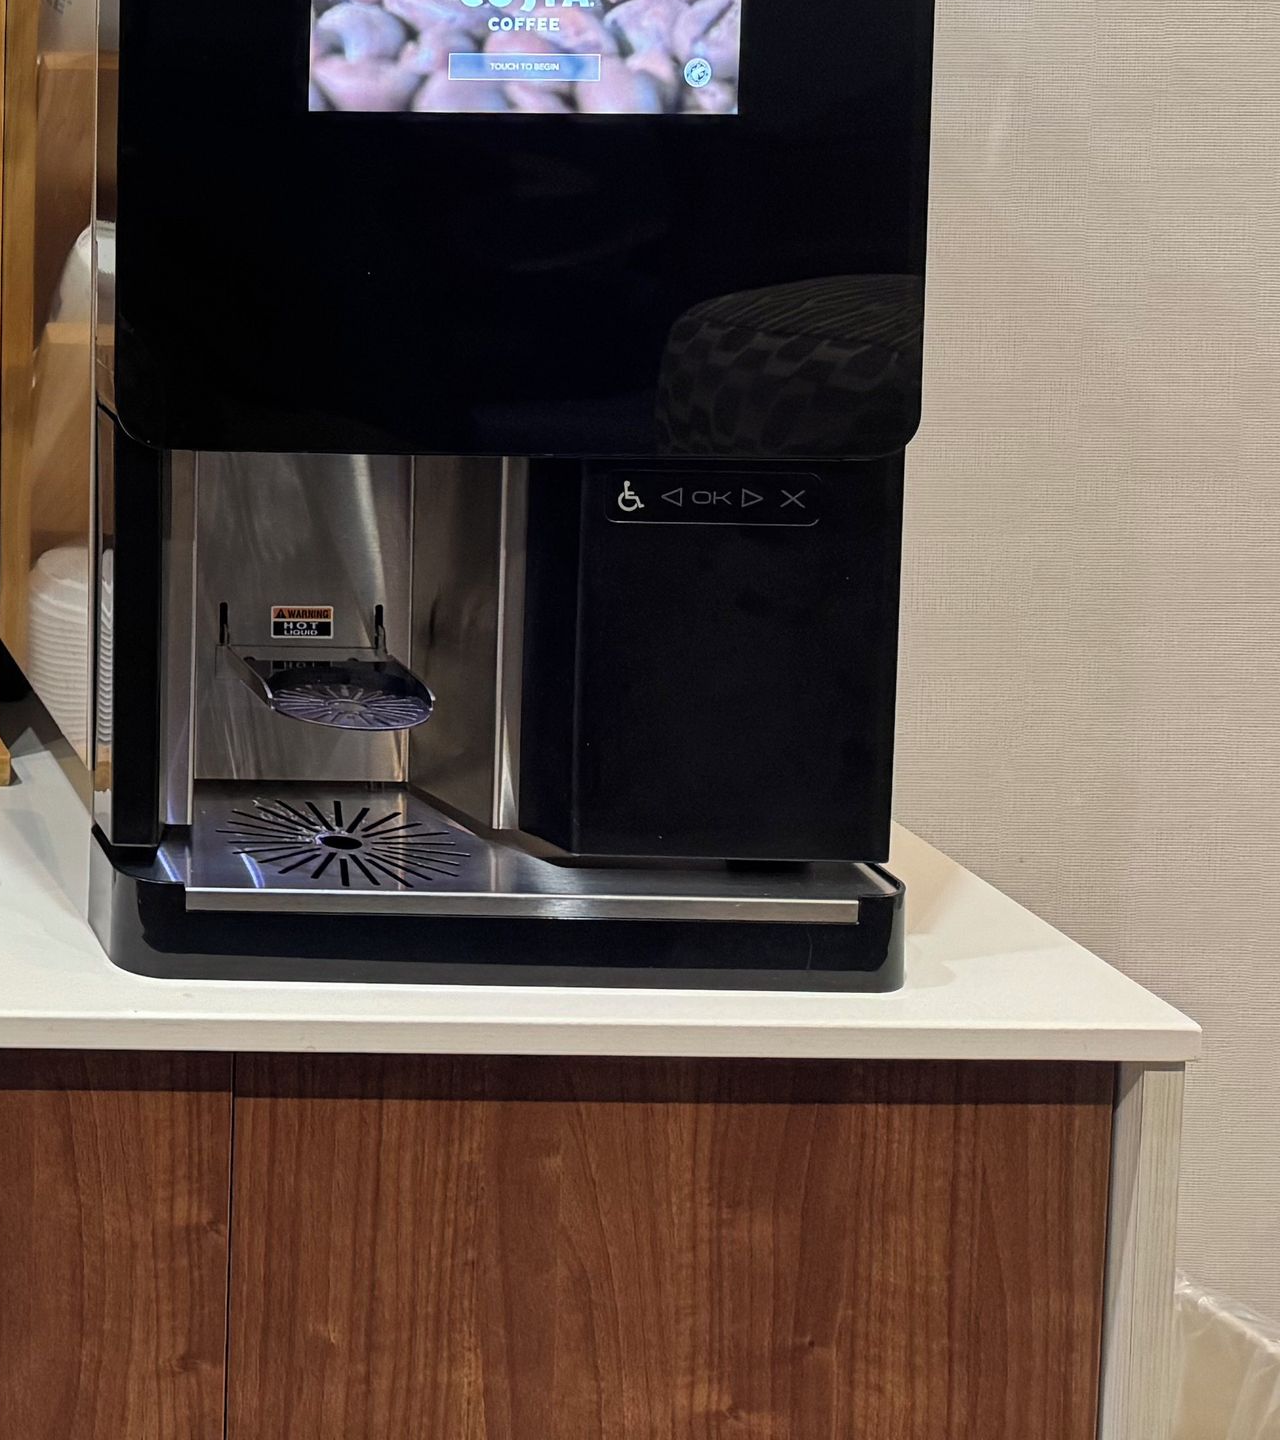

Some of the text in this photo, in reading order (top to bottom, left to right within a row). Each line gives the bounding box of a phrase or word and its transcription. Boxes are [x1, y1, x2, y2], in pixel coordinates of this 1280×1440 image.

[487, 17, 561, 31] COFFEE
[490, 62, 560, 71] TOUCH TO BEGIN
[692, 490, 732, 505] OK
[287, 609, 329, 619] WARNING
[283, 621, 318, 629] HOT
